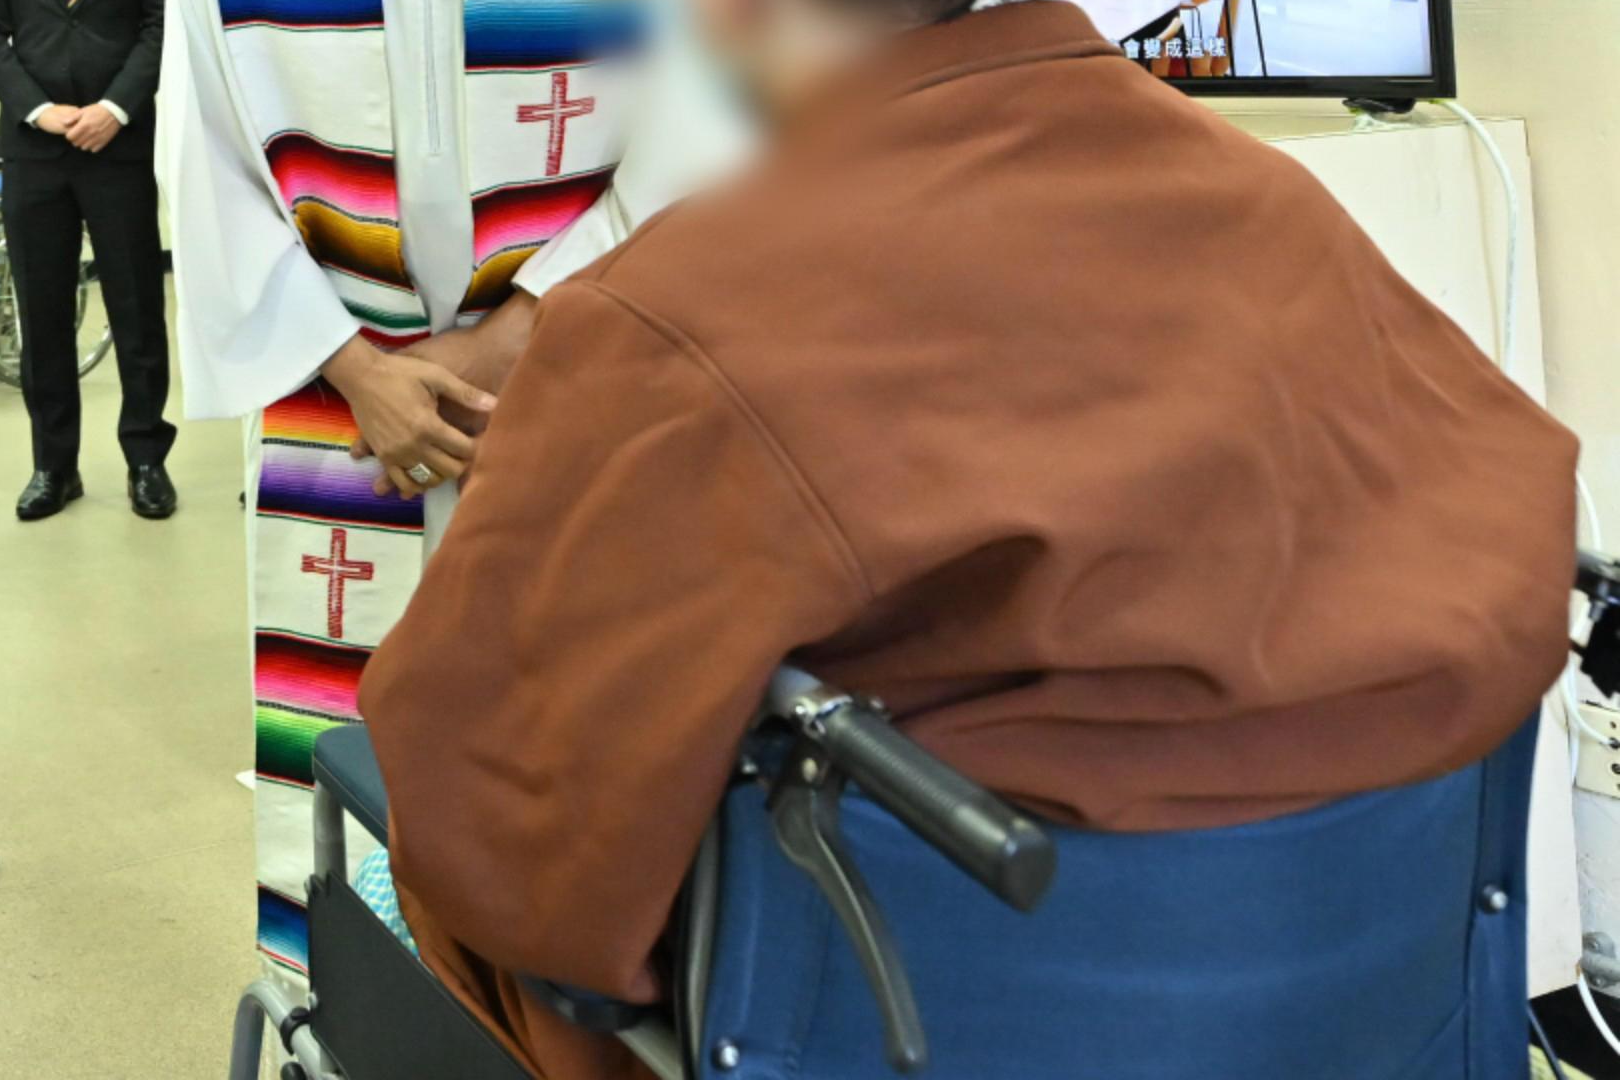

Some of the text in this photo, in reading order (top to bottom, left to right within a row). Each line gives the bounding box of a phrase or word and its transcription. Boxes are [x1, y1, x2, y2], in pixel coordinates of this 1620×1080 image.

[1111, 35, 1227, 59] 會變成這樣
